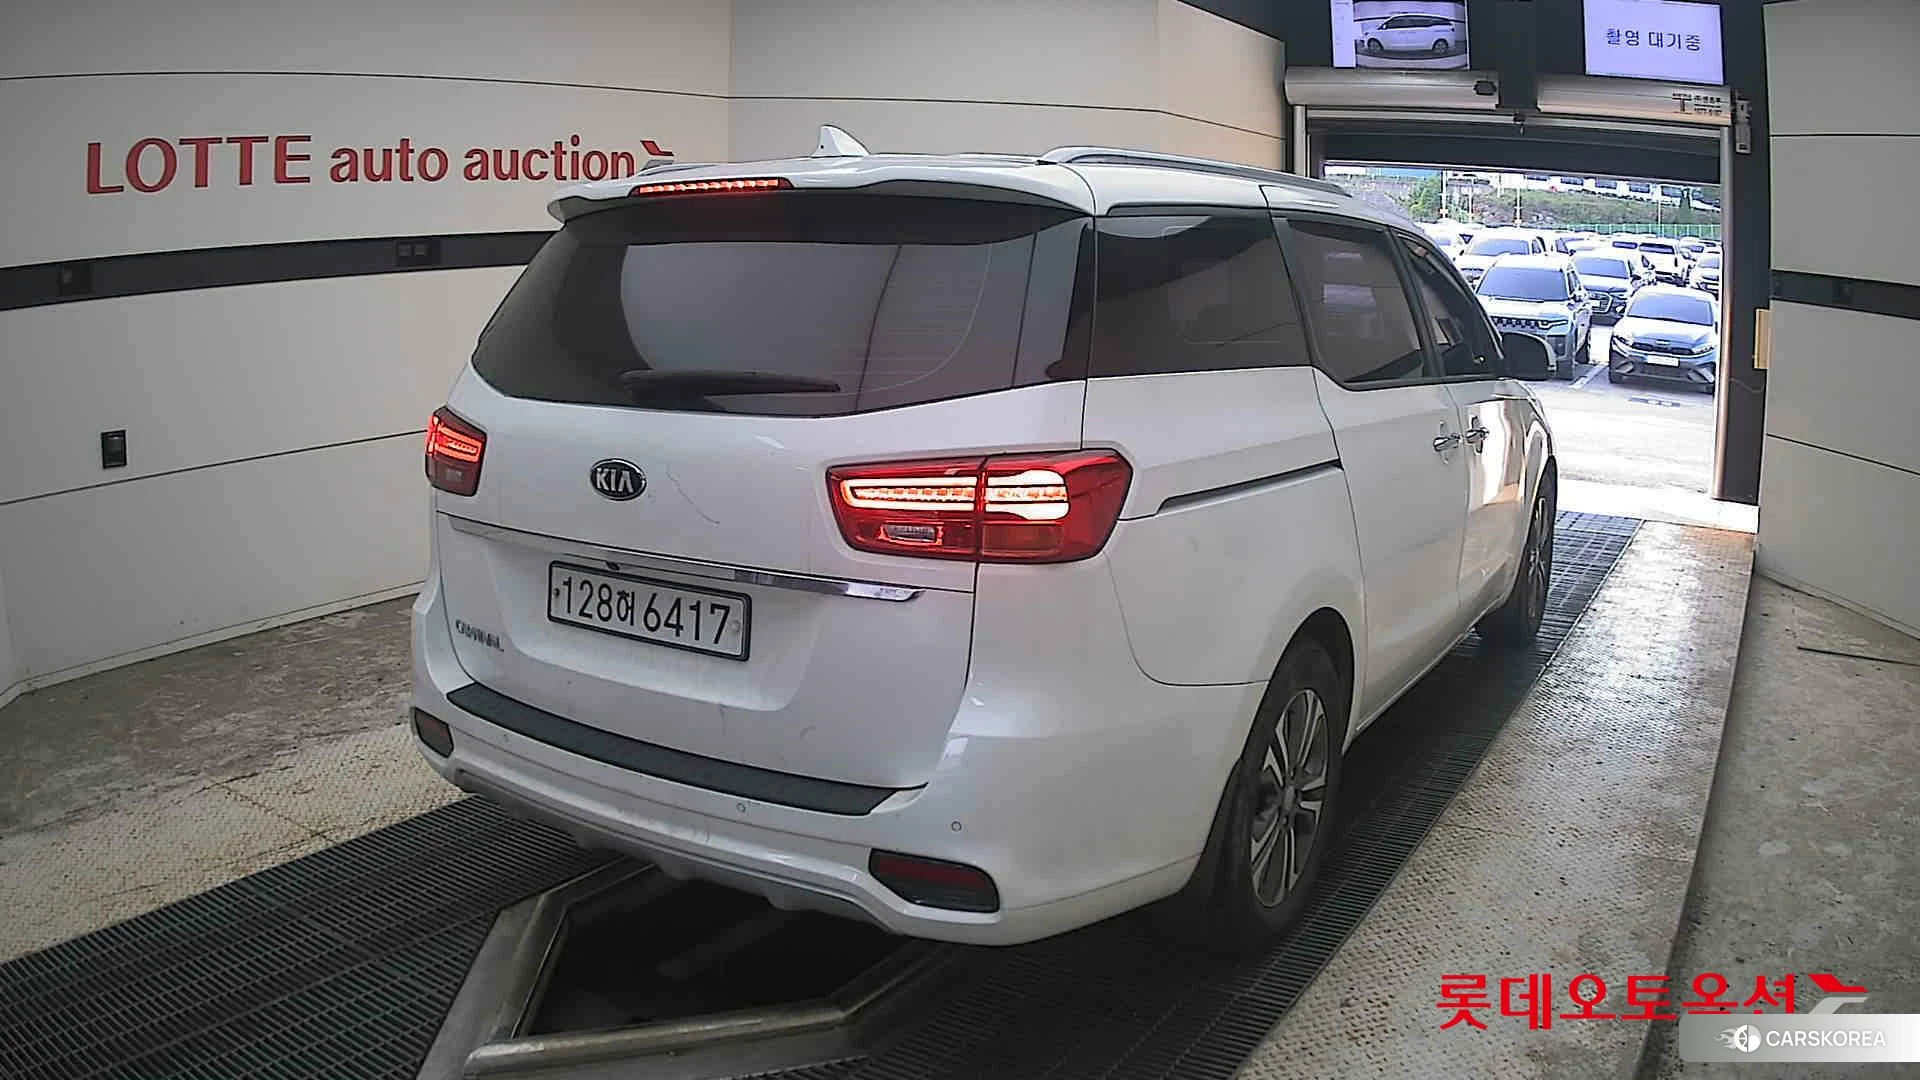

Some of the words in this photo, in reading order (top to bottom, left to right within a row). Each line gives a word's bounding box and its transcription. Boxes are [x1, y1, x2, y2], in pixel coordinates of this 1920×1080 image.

[1647, 31, 1701, 52] 대기중
[86, 135, 312, 194] LOTTE
[329, 138, 449, 182] auto
[463, 134, 635, 181] auction
[596, 467, 634, 493] KIA
